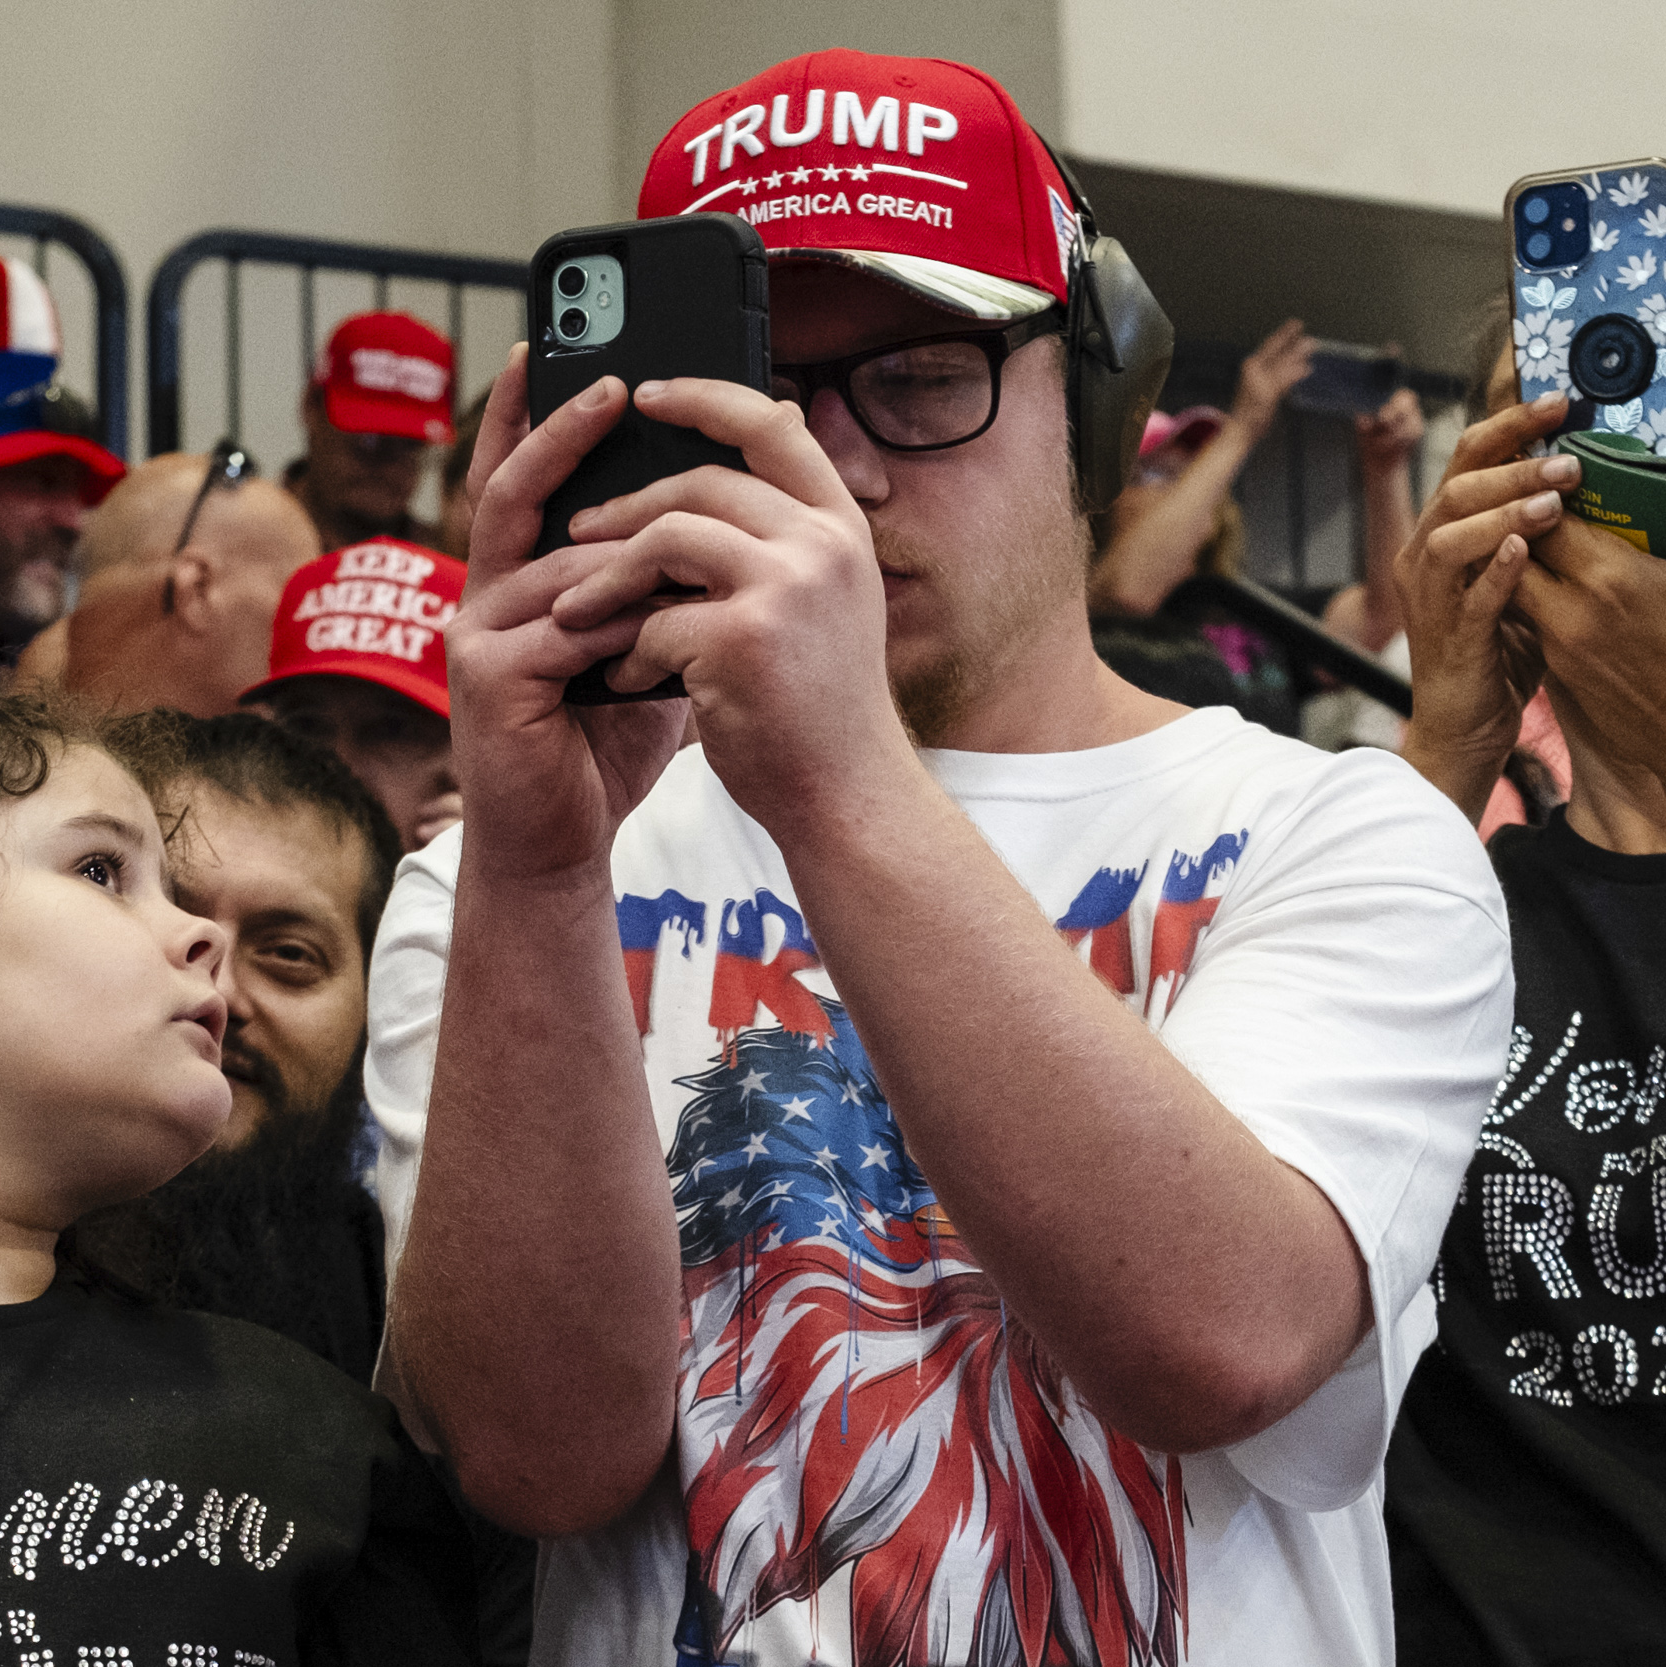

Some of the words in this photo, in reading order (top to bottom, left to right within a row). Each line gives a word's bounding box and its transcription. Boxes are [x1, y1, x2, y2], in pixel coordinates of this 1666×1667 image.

[684, 88, 959, 187] TRUMP
[856, 193, 954, 229] GREAT!
[1578, 487, 1602, 505] OIN
[1583, 504, 1632, 525] TRUMP
[335, 543, 435, 587] KEEP
[305, 615, 435, 664] GREAT
